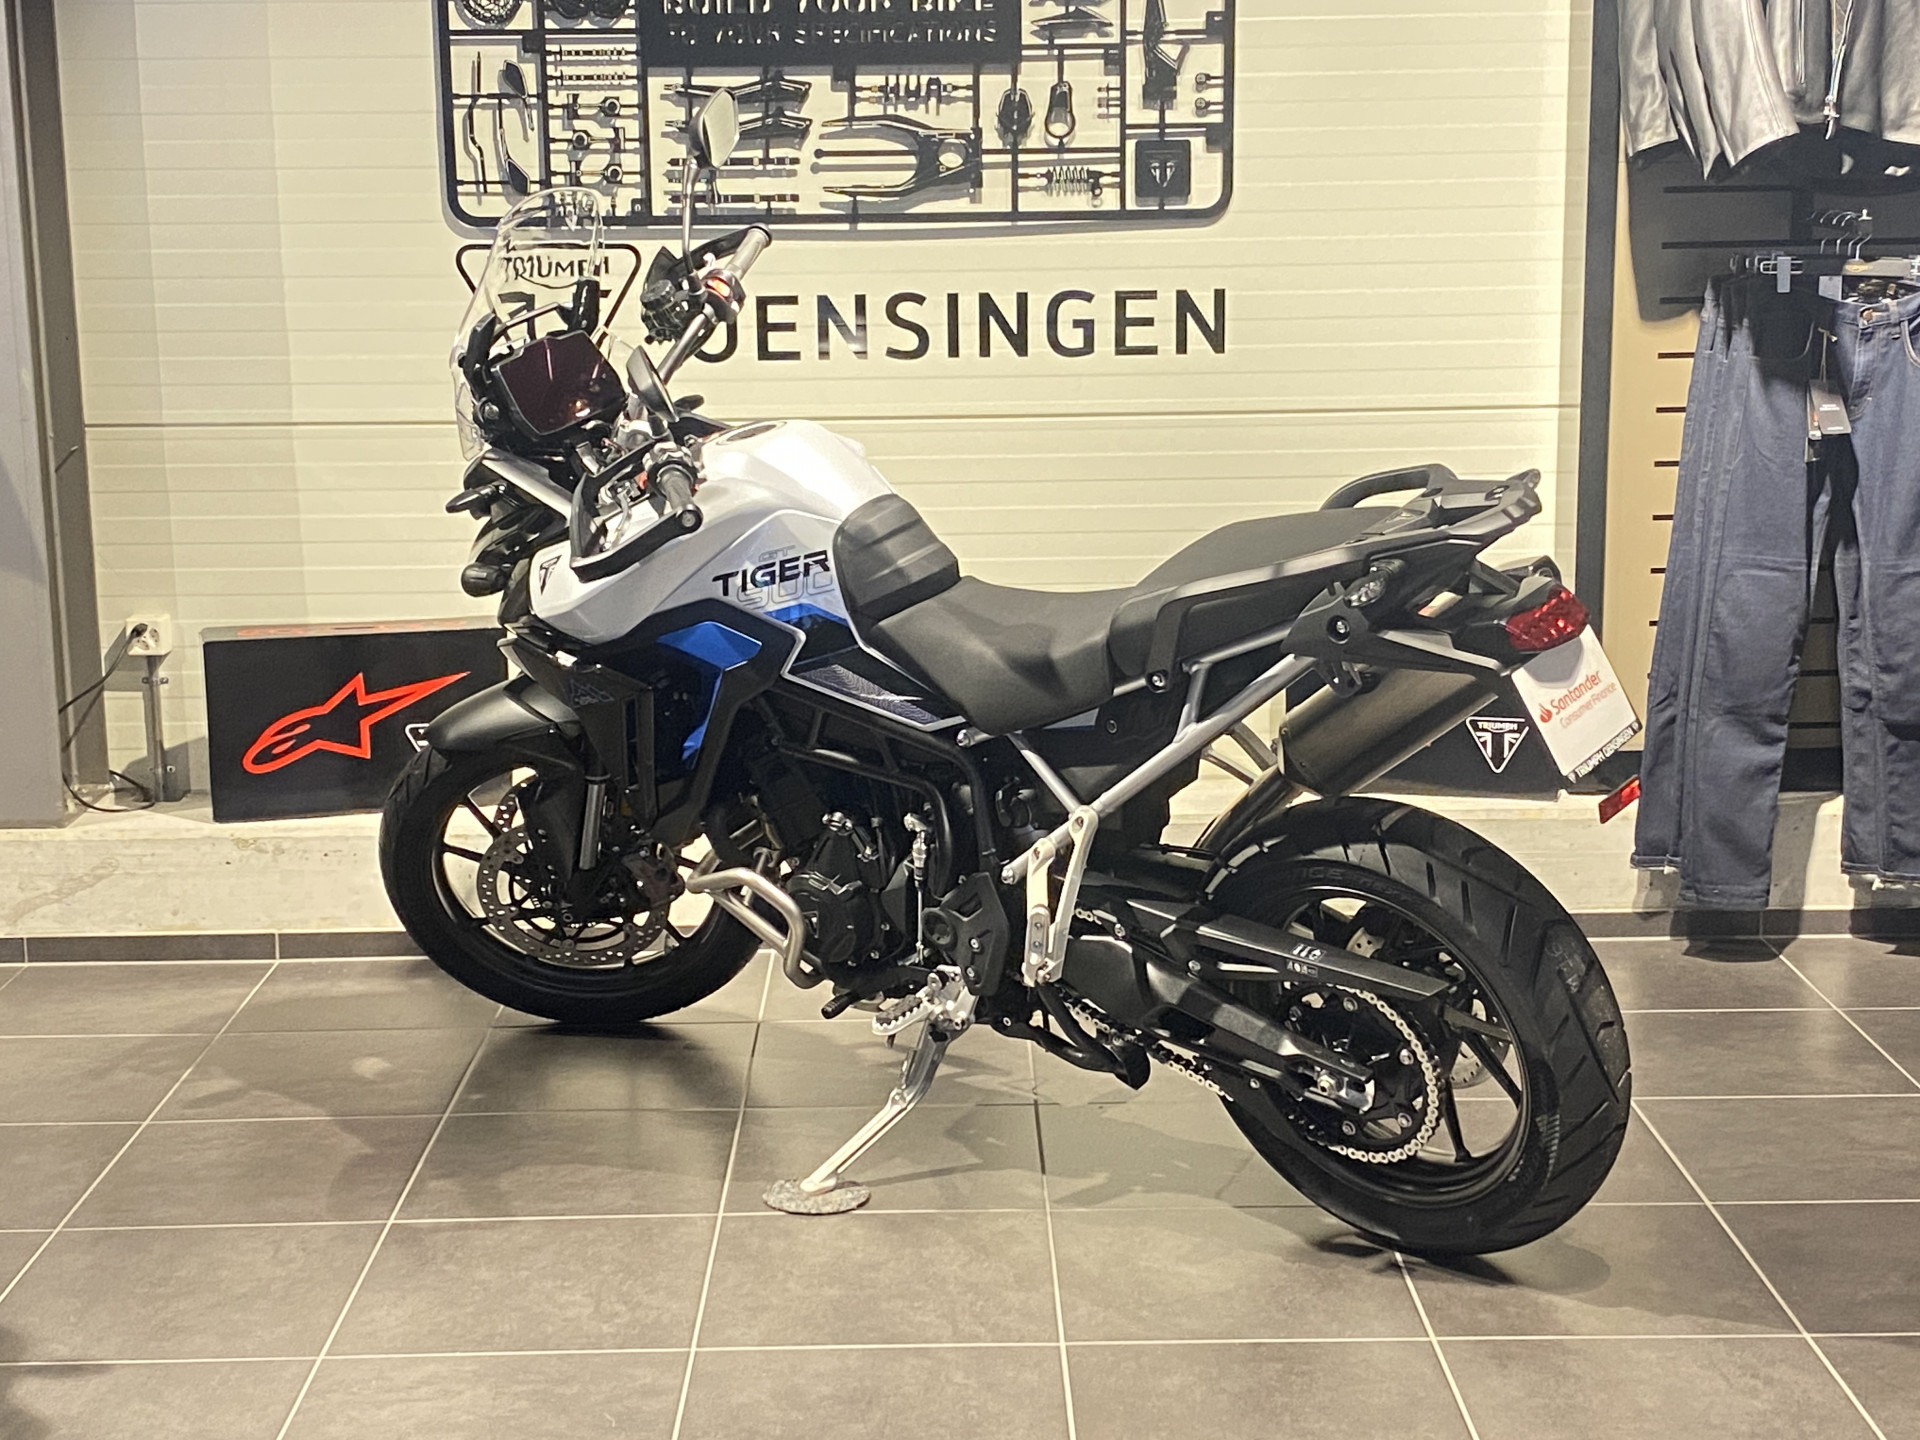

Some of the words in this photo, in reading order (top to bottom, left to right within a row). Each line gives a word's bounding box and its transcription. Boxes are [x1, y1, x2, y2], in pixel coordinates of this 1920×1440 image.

[793, 20, 997, 44] SPECIFICATIONS
[712, 550, 831, 597] TIGER
[1550, 670, 1602, 716] Santander
[1560, 698, 1593, 729] Consumer
[1591, 682, 1617, 706] Finance
[1476, 721, 1518, 732] TRIUMPH
[1575, 750, 1606, 778] TRIUMPH
